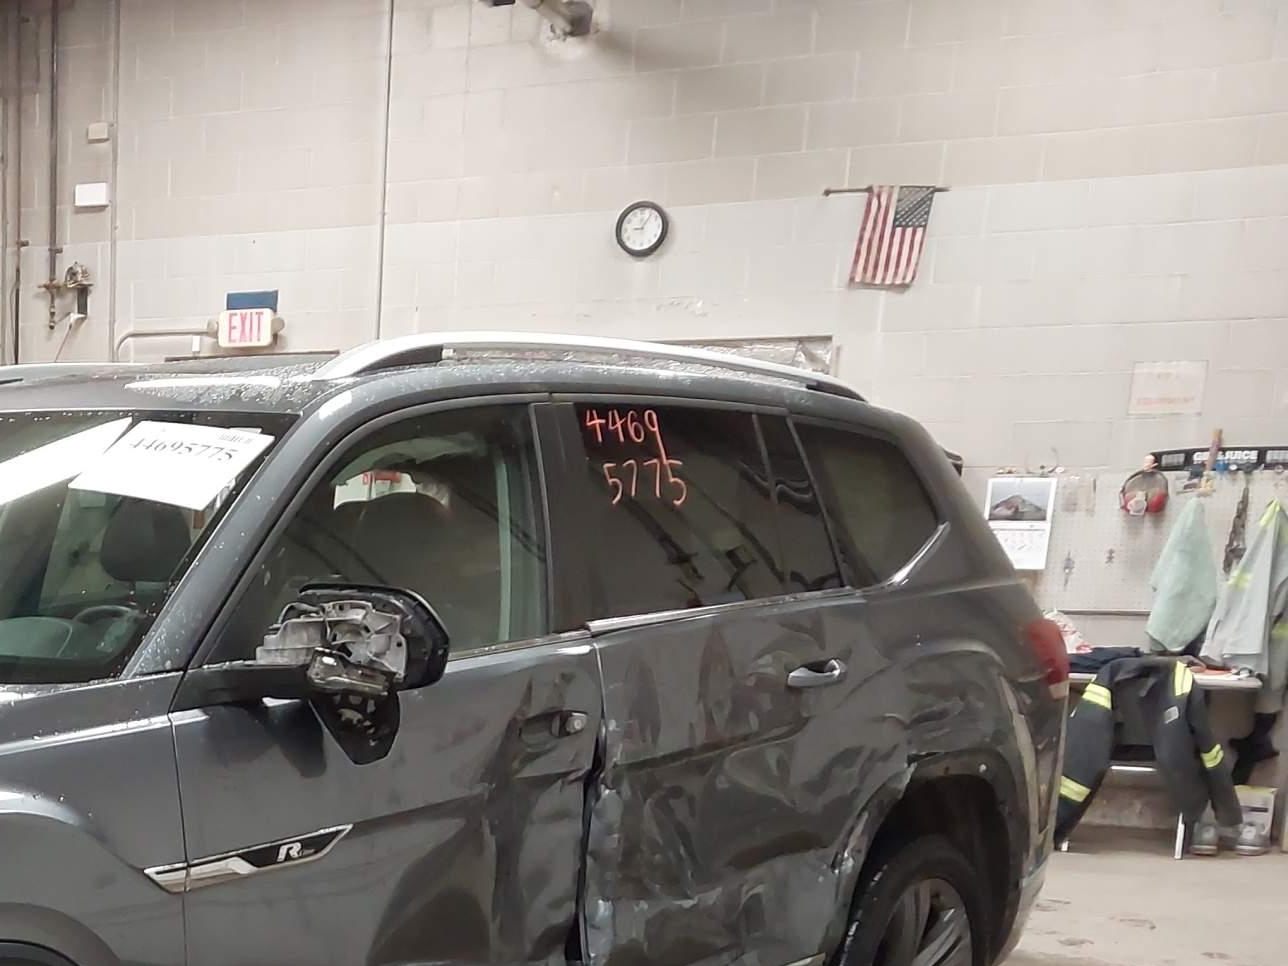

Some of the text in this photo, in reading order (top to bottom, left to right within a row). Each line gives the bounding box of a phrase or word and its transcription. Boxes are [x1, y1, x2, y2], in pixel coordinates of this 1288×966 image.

[228, 311, 264, 343] EXIT
[585, 409, 669, 465] 4469
[603, 458, 687, 506] 5775
